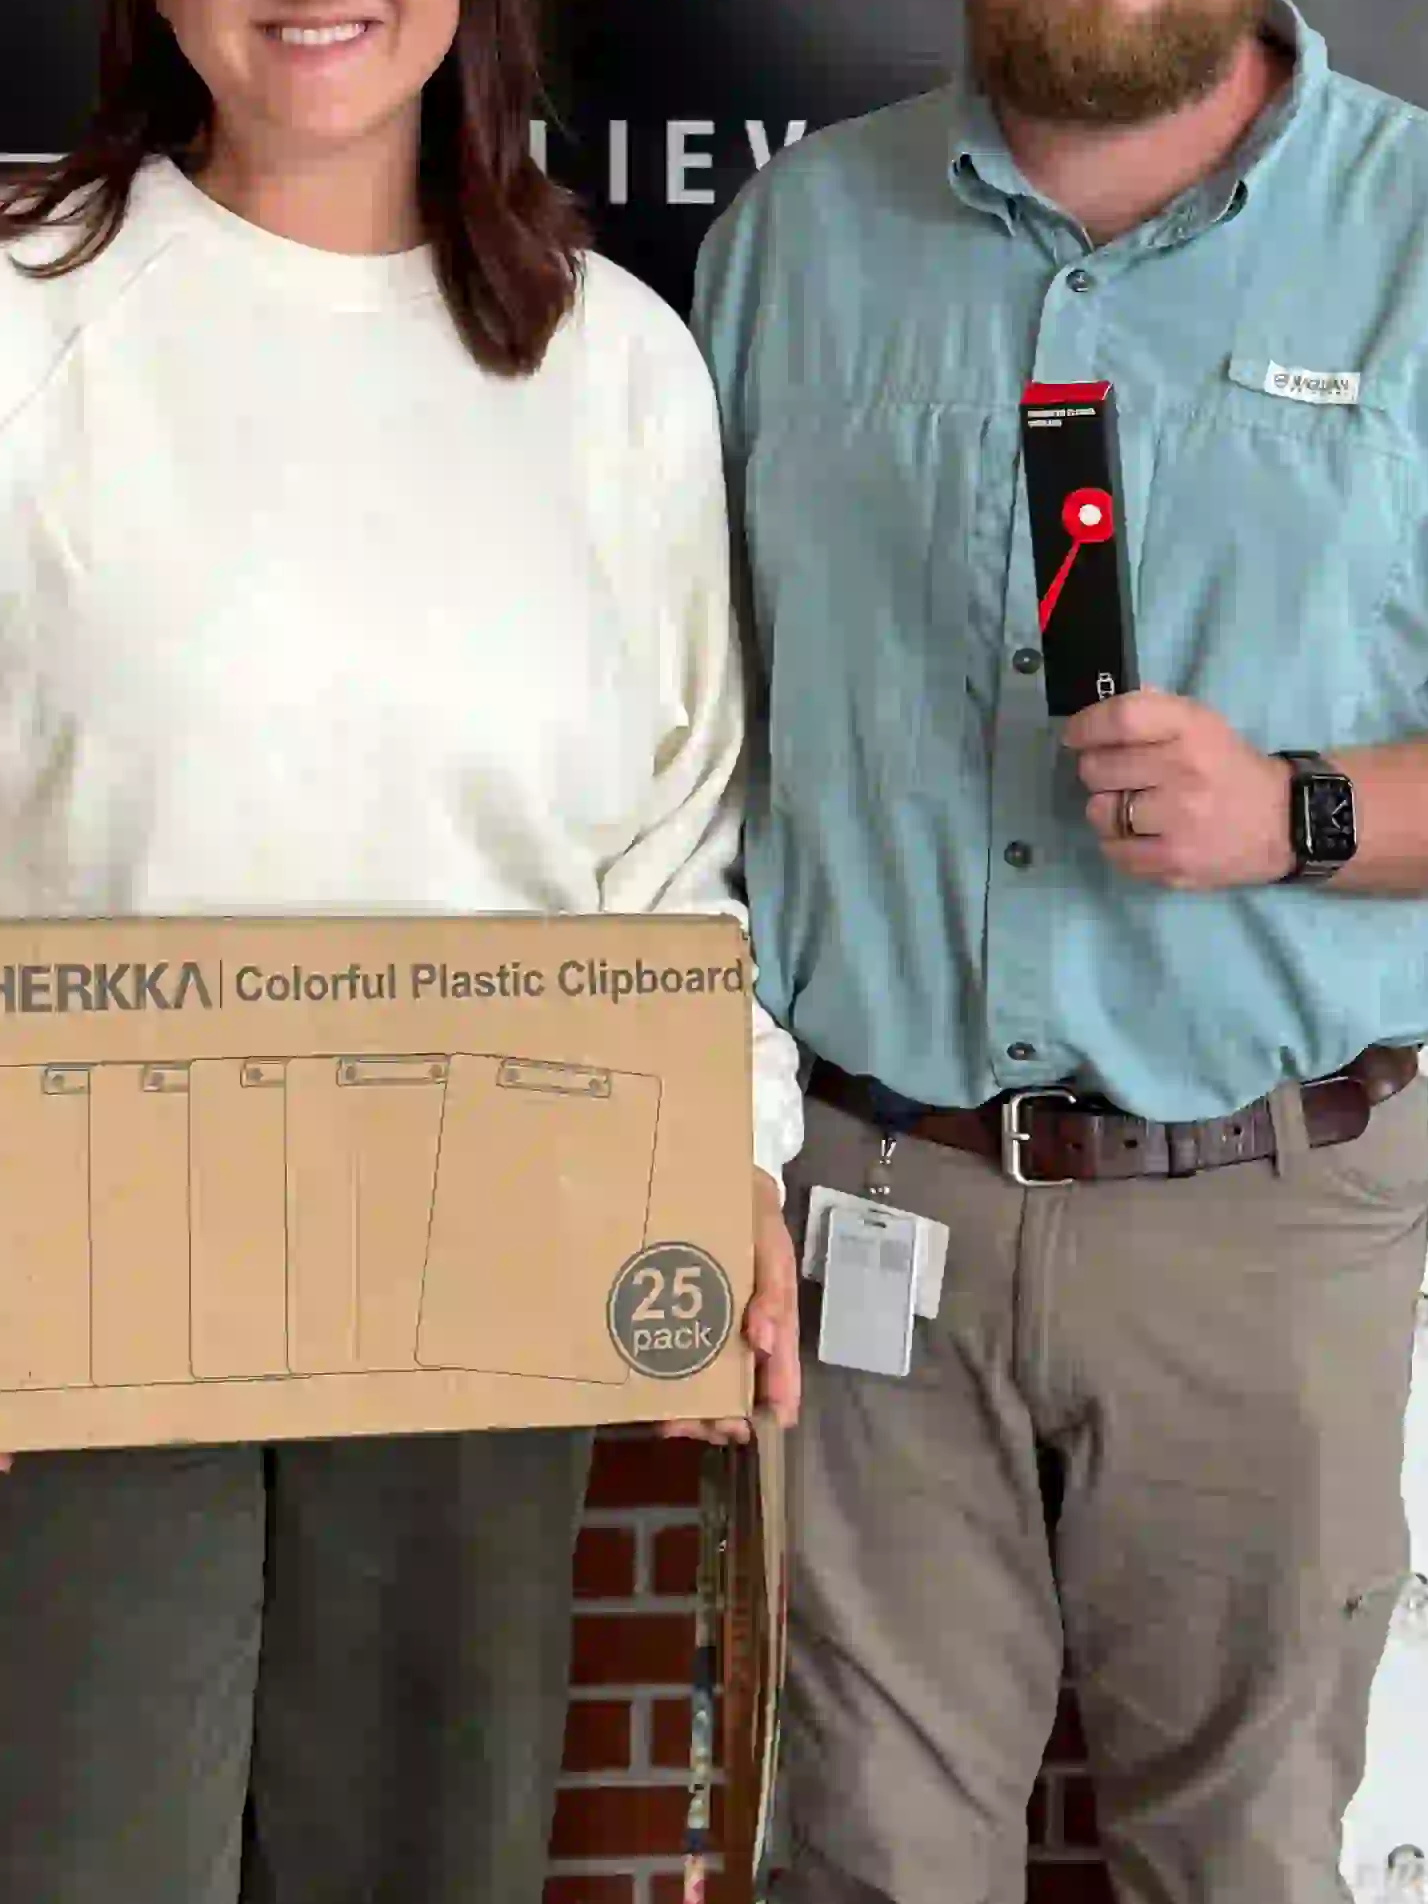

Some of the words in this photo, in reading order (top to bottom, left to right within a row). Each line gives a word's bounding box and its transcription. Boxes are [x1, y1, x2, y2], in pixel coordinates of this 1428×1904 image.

[236, 962, 395, 1002] Colorful
[411, 960, 545, 999] Plastic
[558, 958, 744, 1004] Clipboard
[631, 1267, 703, 1321] 25
[632, 1321, 713, 1356] pack
